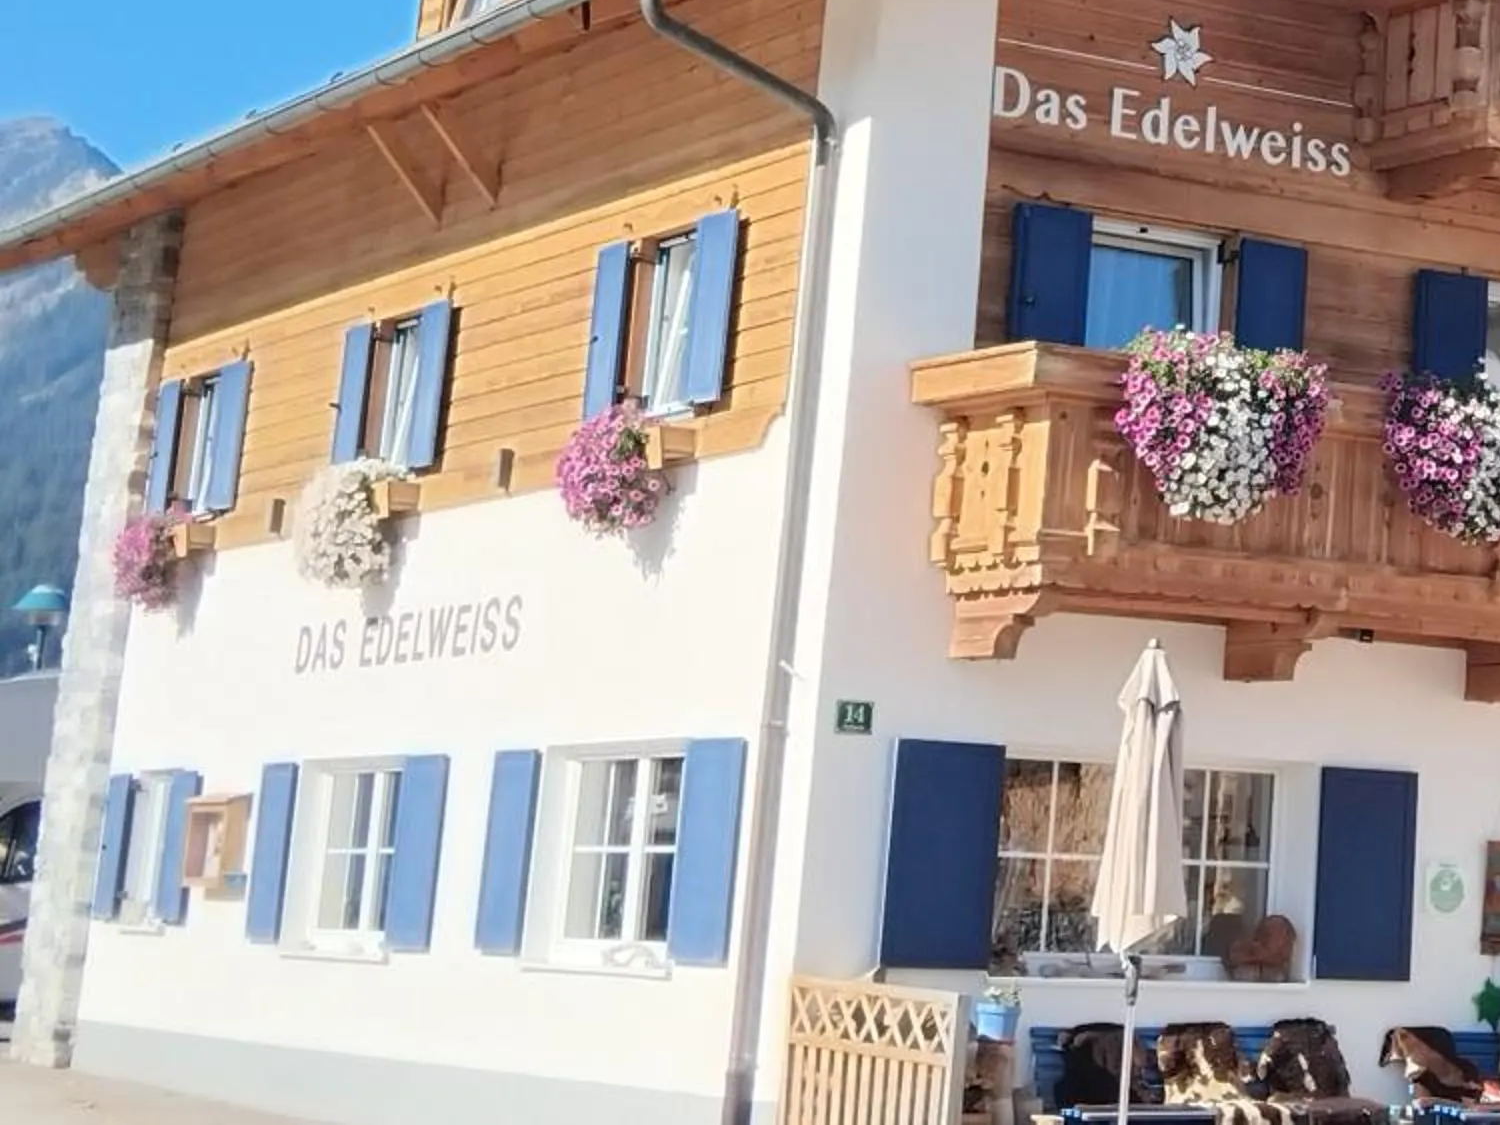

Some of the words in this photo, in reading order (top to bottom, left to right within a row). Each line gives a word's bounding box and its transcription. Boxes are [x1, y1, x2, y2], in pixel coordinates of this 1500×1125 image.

[993, 66, 1088, 130] Das
[1110, 87, 1352, 177] Edelweiss
[294, 619, 347, 674] DAS
[359, 594, 524, 667] EDELWEISS
[844, 705, 865, 723] 14
